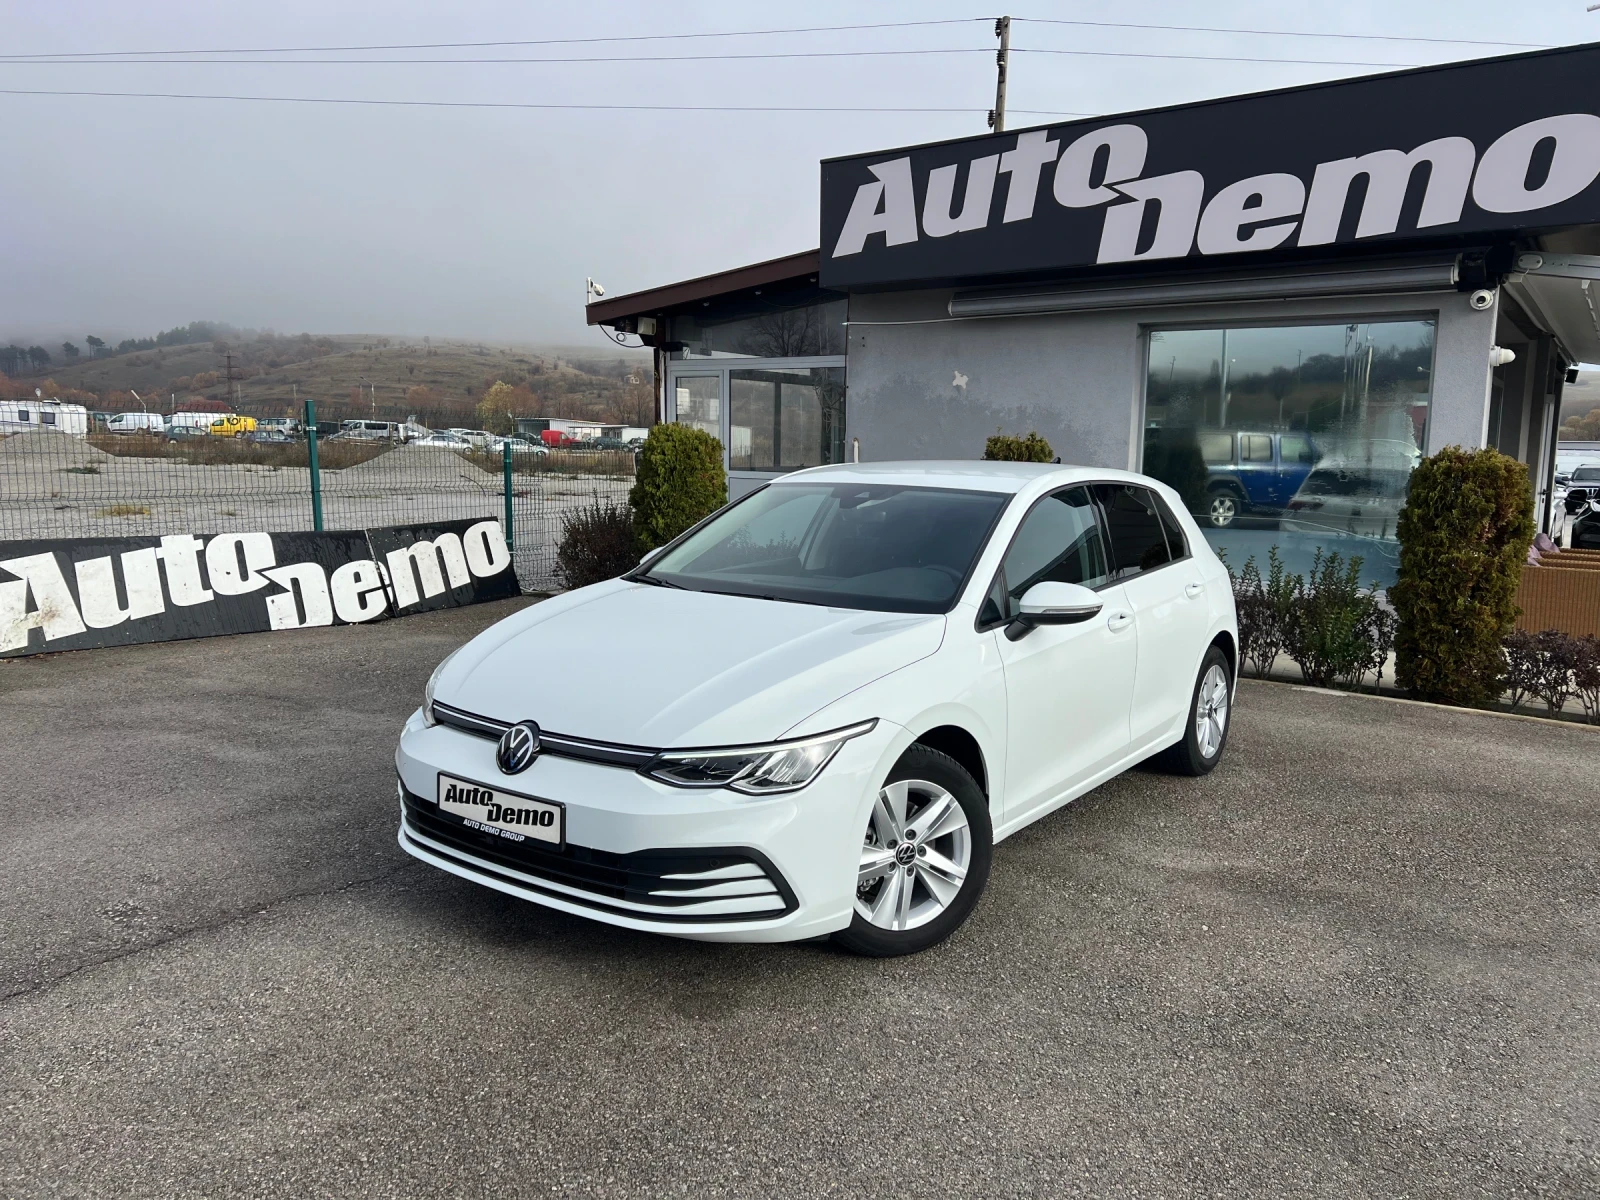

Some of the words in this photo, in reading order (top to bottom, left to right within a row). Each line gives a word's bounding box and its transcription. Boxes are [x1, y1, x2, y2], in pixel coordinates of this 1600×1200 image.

[832, 124, 1148, 258] Auto
[1097, 113, 1600, 264] Demo
[0, 532, 276, 652] Auto
[257, 521, 511, 630] Demo
[445, 784, 493, 806] Auto
[487, 803, 554, 827] Demo
[463, 818, 480, 829] AUTO
[480, 824, 500, 836] DEMO
[500, 830, 525, 842] GROUP
